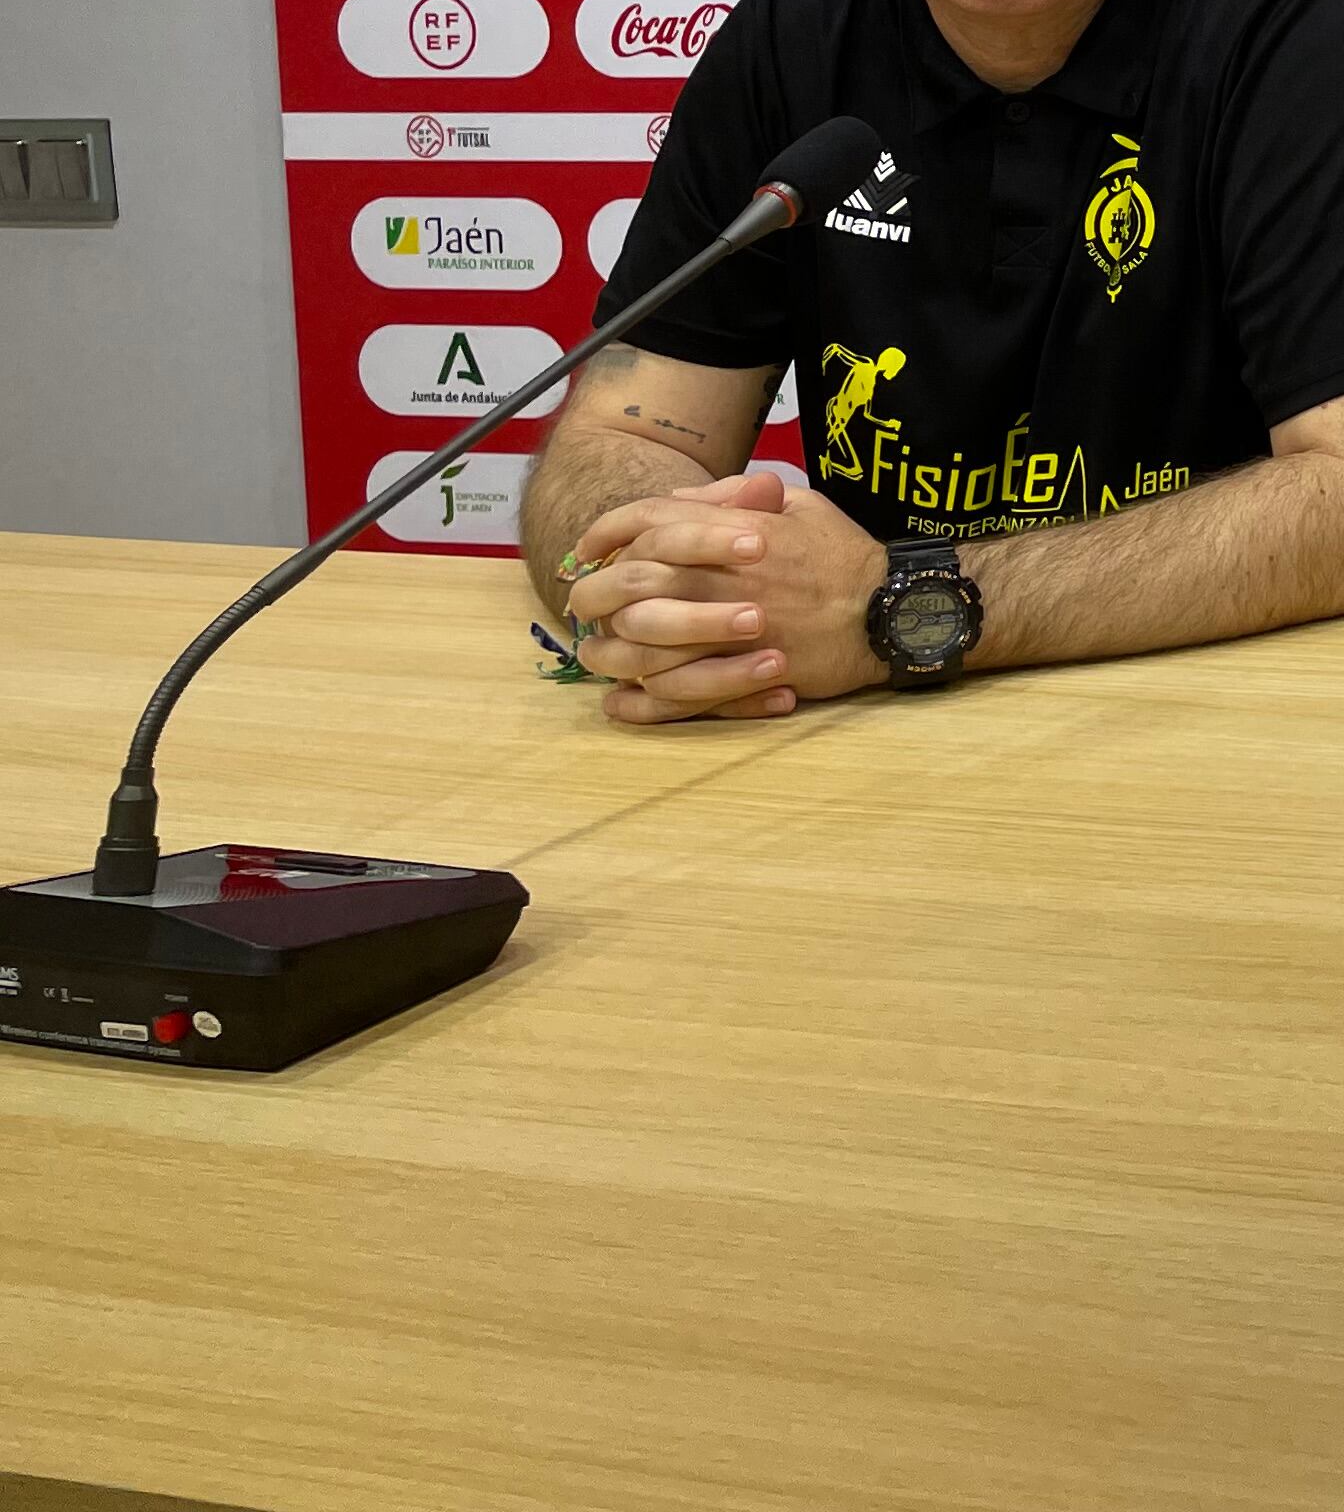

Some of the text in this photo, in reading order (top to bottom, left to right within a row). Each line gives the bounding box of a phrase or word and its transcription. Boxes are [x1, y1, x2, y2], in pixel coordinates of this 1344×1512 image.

[425, 217, 503, 254] Jaén
[428, 258, 534, 270] PARAÍSO INTERIOR
[1122, 252, 1148, 274] SALA
[1125, 462, 1189, 499] Jaén
